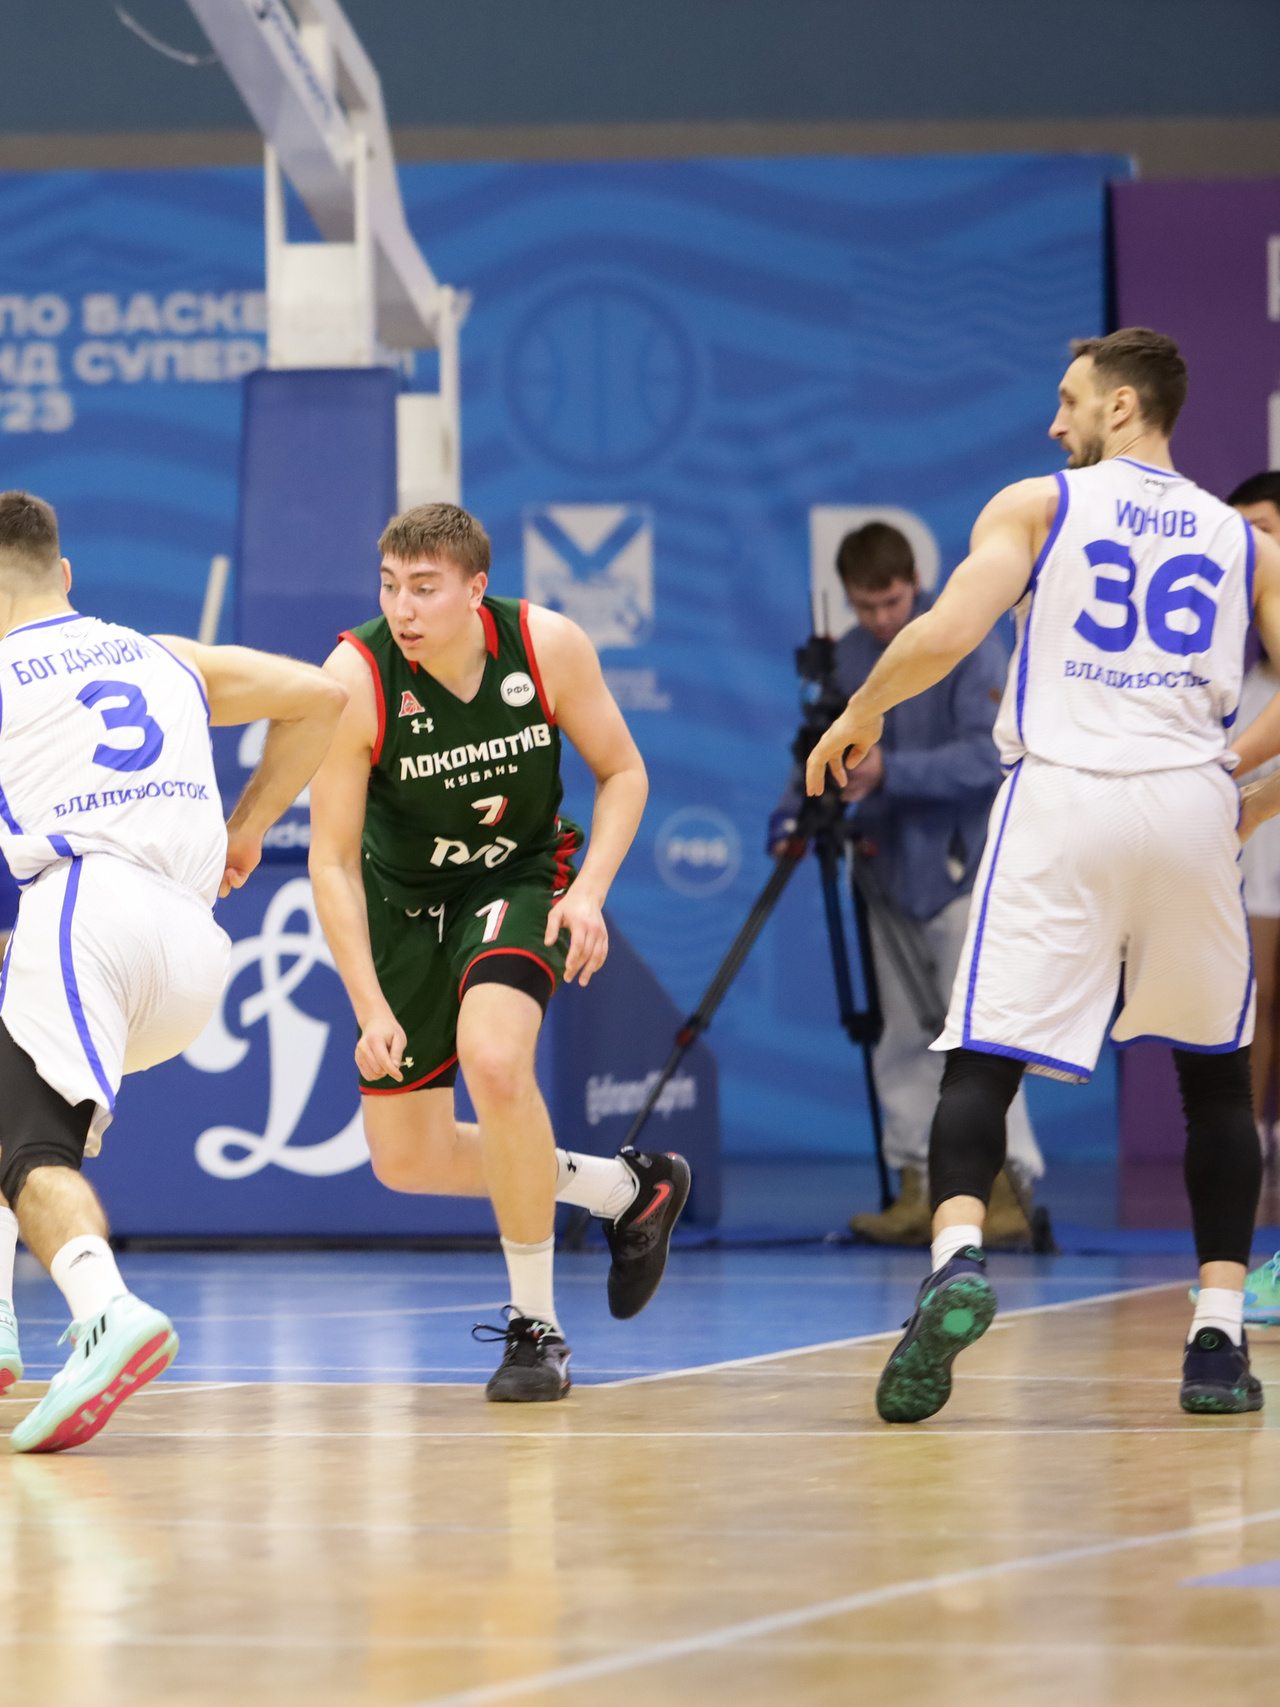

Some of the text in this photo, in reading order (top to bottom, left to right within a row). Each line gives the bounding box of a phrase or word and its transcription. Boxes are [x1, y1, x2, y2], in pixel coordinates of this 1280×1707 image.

[81, 292, 268, 335] БАСКЕ
[73, 340, 265, 383] СУПЕР
[1073, 539, 1226, 657] 36
[11, 638, 154, 686] БОГДАНОВИ
[1064, 660, 1212, 689] ВЛАДИВОСТ
[506, 684, 531, 696] РФБ
[75, 680, 165, 772] 3
[400, 723, 552, 781] ЛОКОМОТИВ
[444, 763, 518, 789] КУБАНЬ
[471, 794, 509, 827] 7
[475, 898, 510, 944] 7
